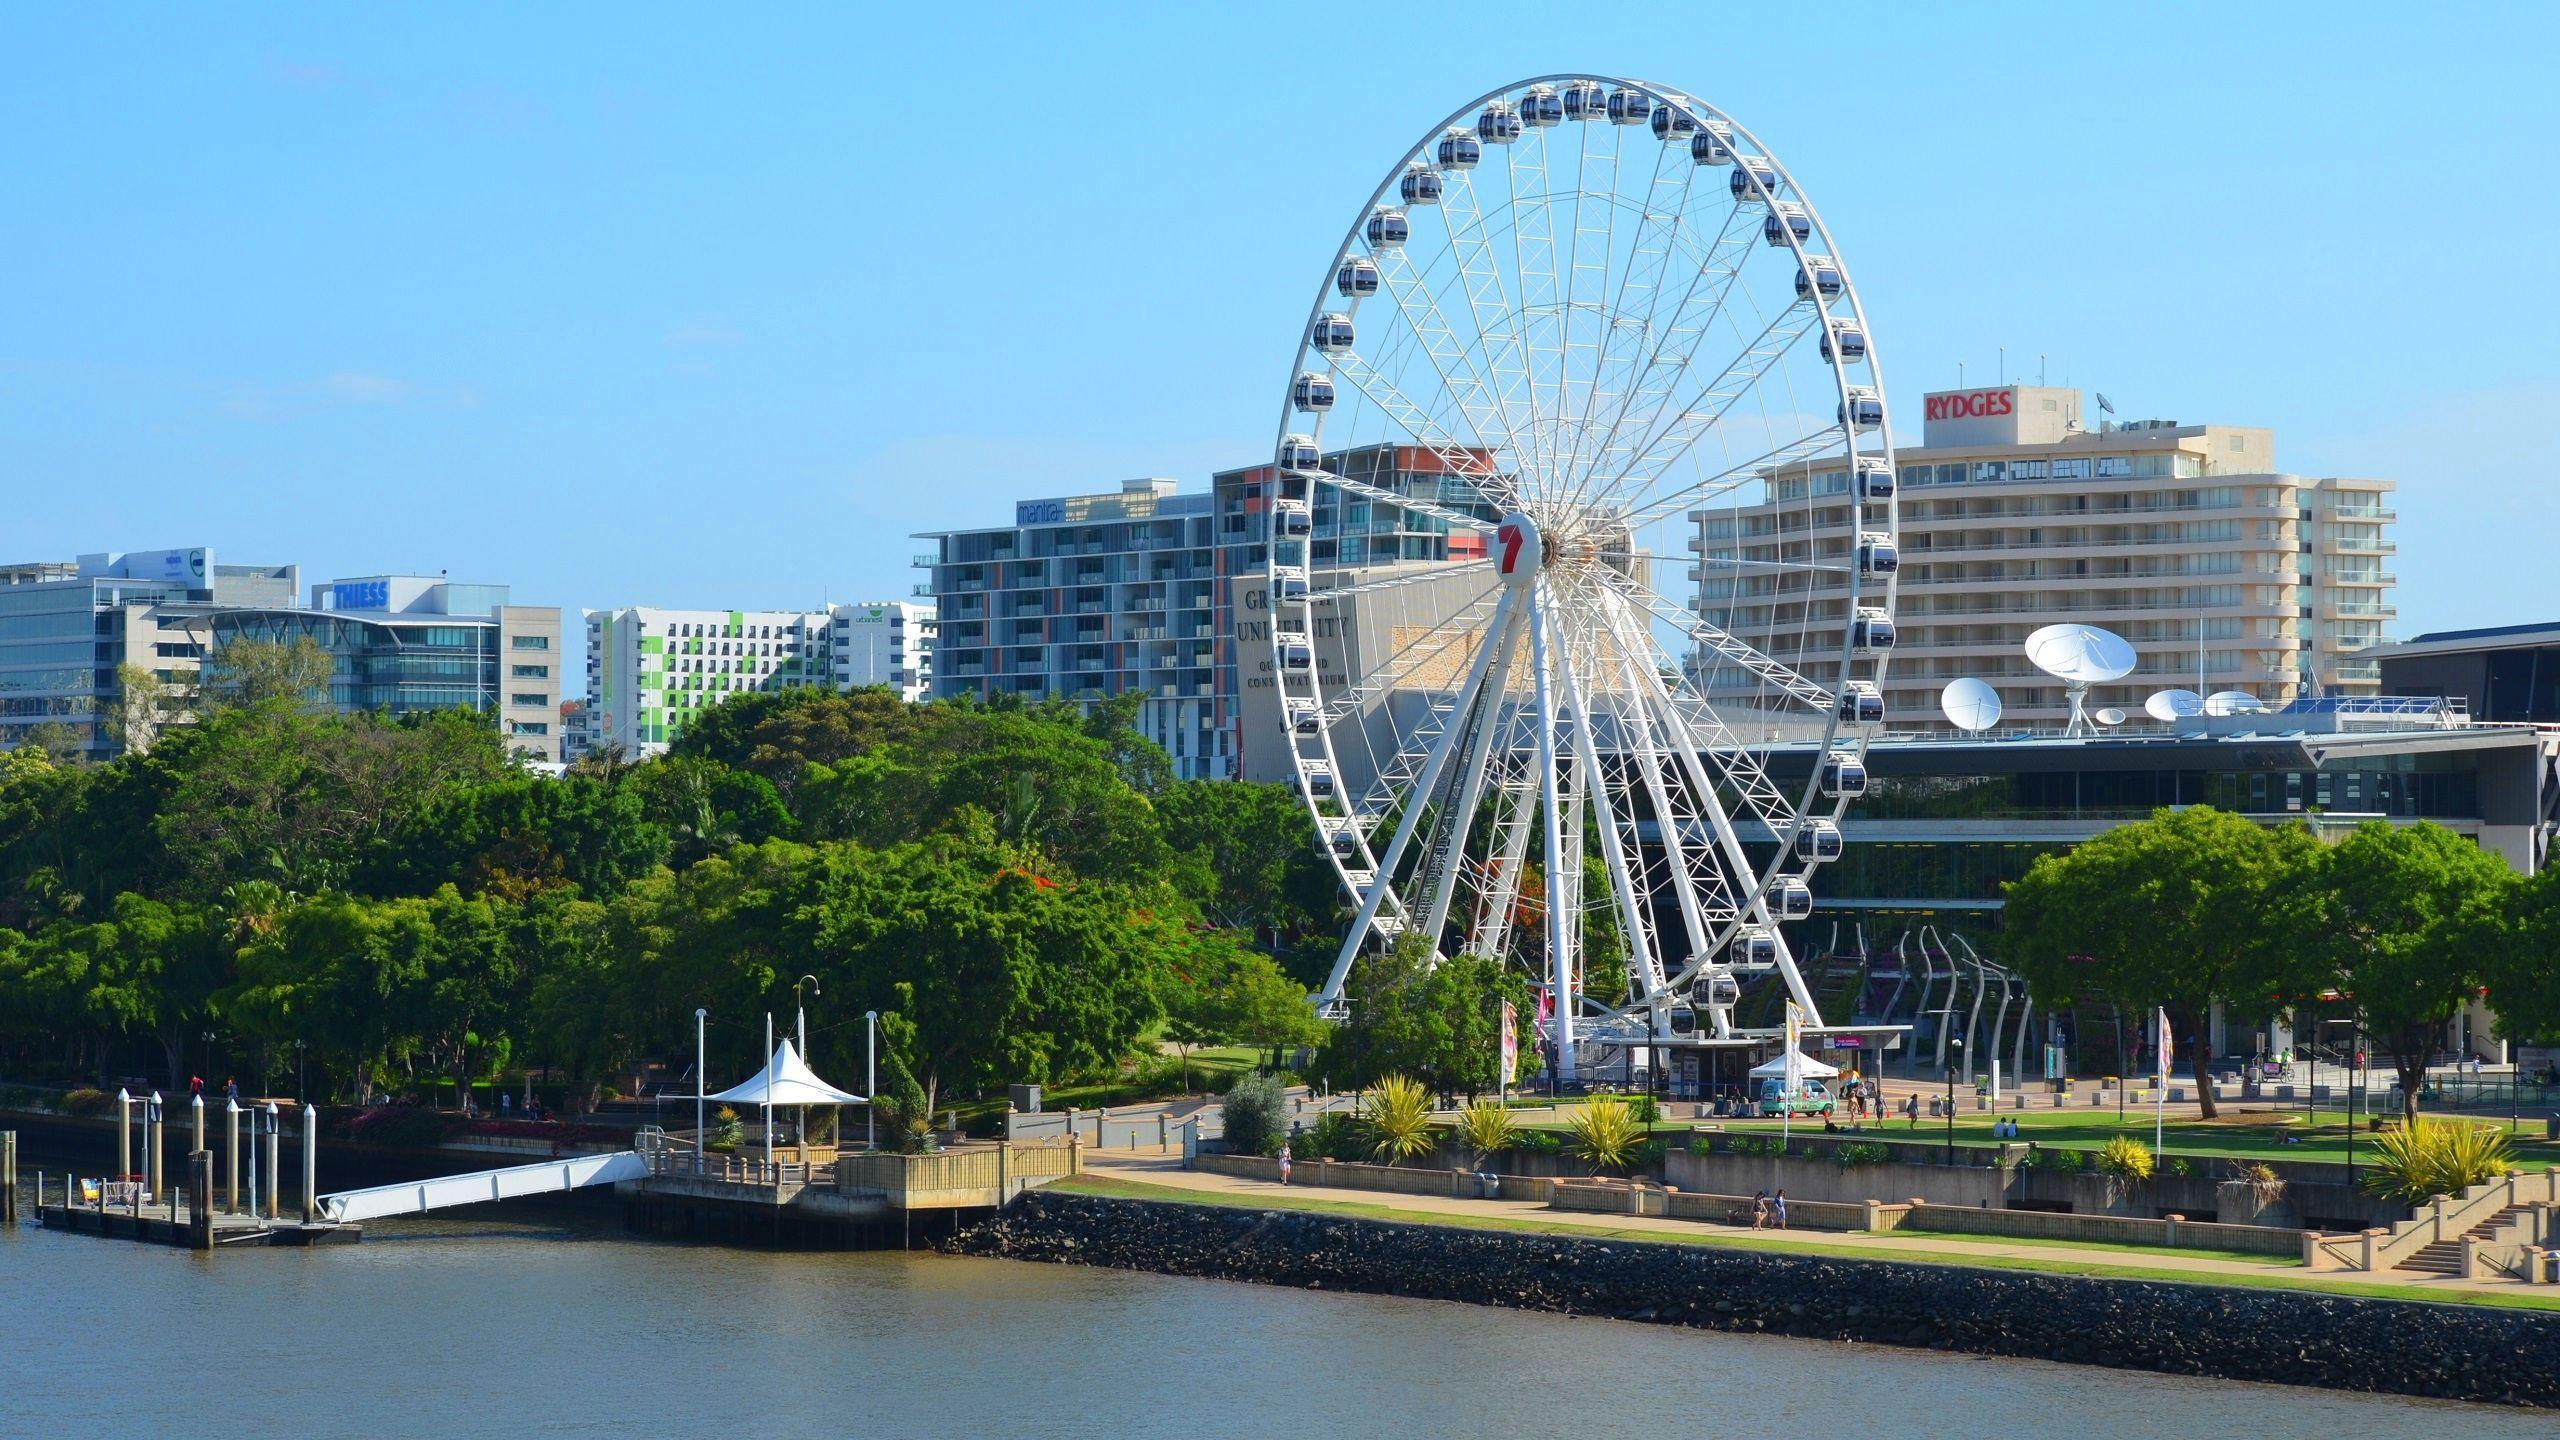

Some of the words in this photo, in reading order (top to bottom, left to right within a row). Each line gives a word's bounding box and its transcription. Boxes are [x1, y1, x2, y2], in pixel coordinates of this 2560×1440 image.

[1925, 391, 2012, 421] RYDGES
[1018, 501, 1064, 524] mantra
[1498, 524, 1524, 574] 7
[334, 581, 388, 609] THIESS
[1237, 617, 1348, 641] UNIERITY
[1247, 674, 1345, 688] CONSRVATRIUM
